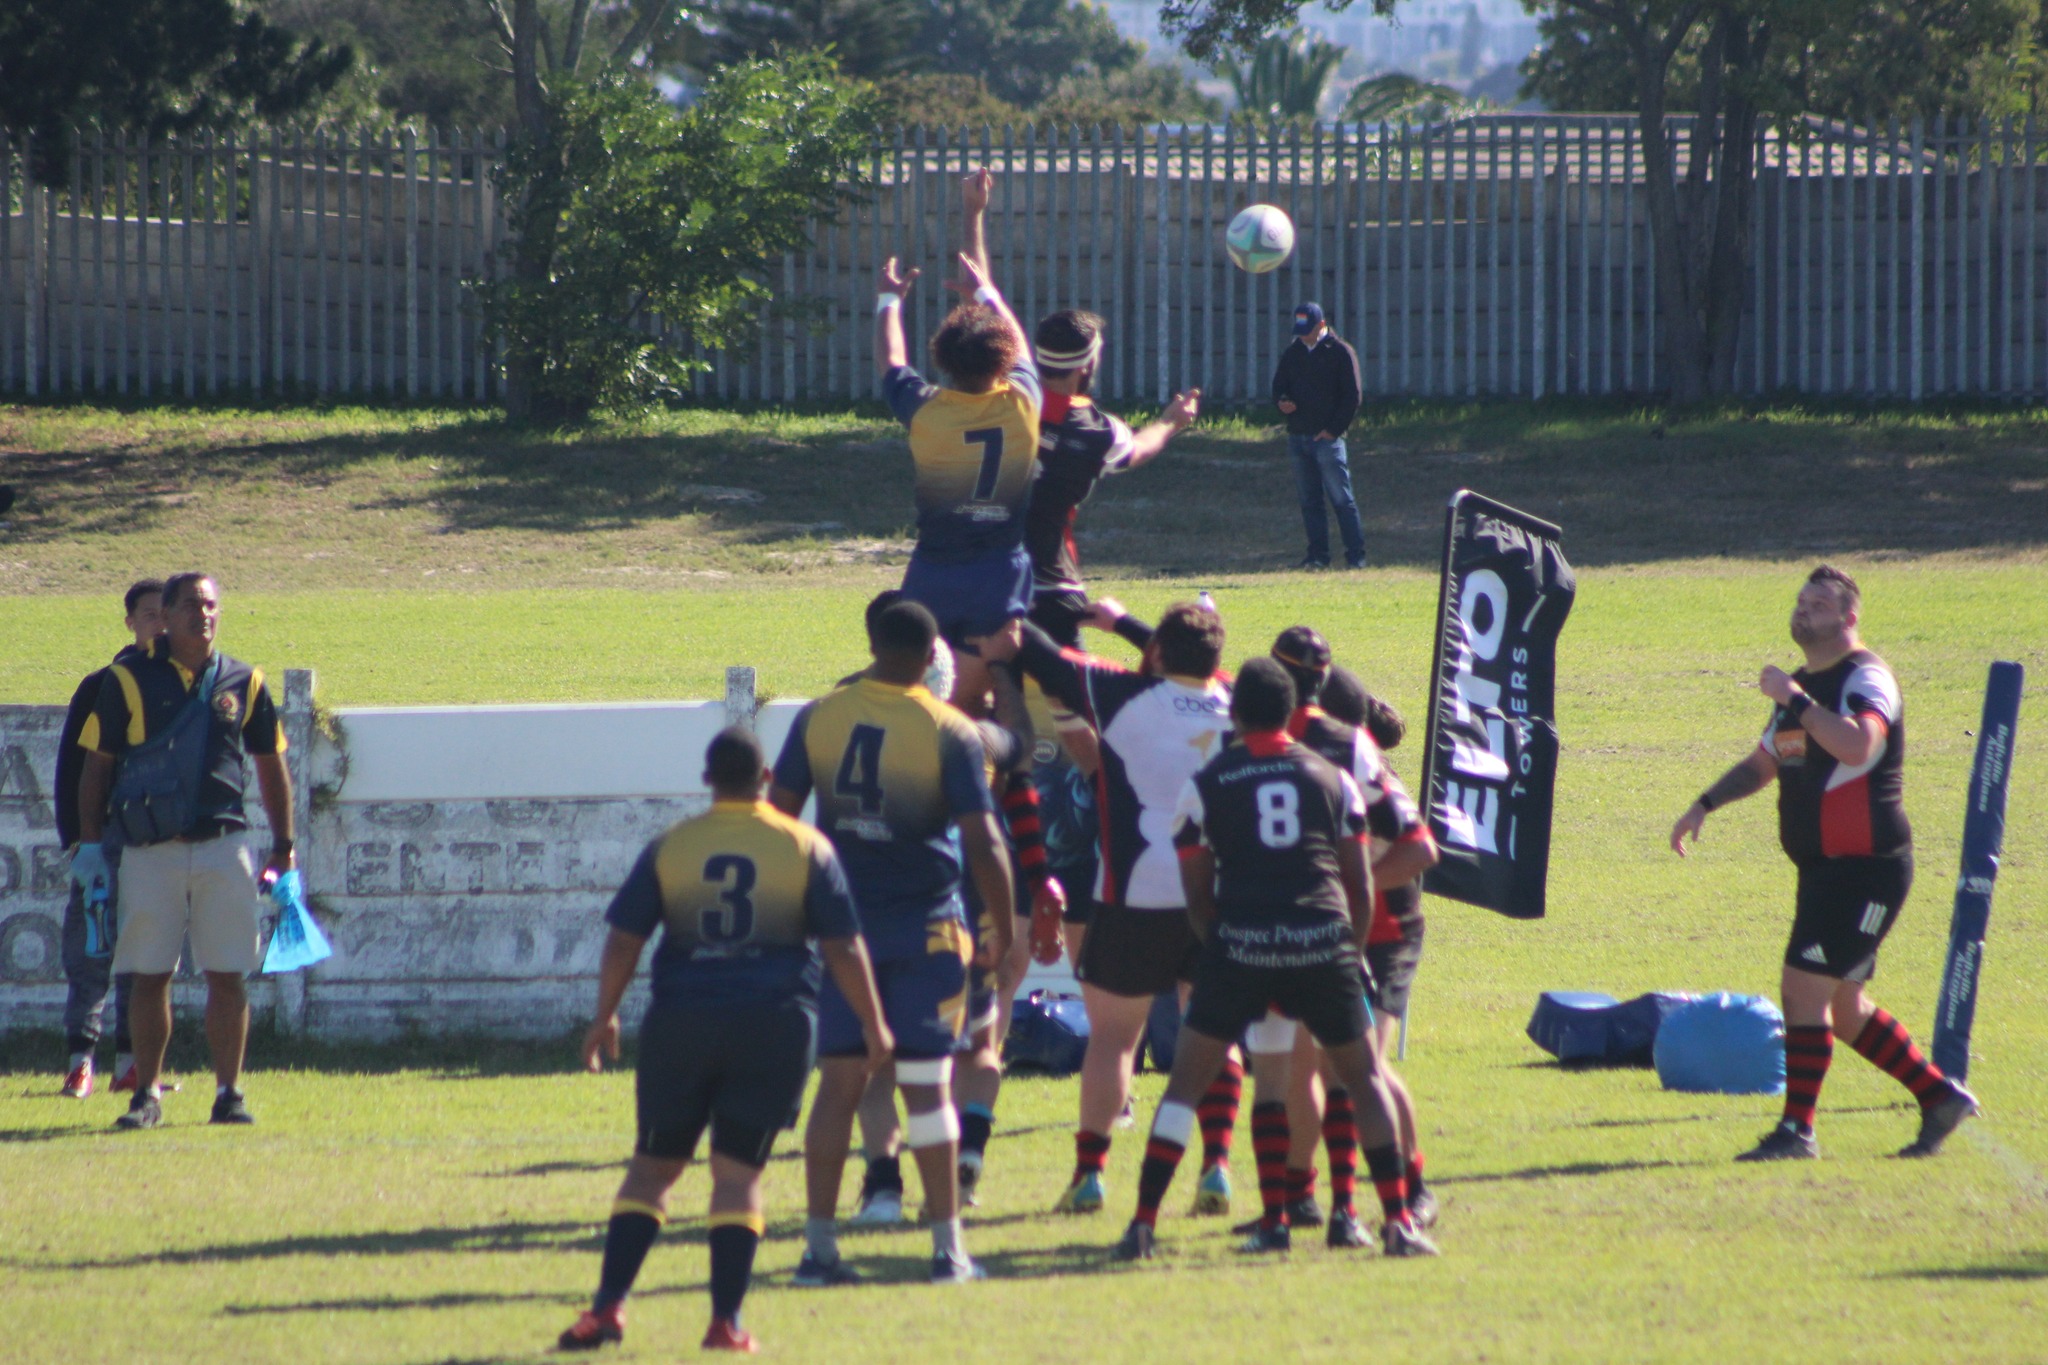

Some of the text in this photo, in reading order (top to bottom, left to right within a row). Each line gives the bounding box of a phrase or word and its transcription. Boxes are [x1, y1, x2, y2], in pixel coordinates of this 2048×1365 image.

[963, 426, 1004, 501] 7
[1511, 646, 1532, 798] TOWERS
[833, 722, 886, 816] 4
[1256, 780, 1300, 848] 8
[698, 851, 758, 943] 3
[1274, 920, 1341, 948] Property
[1226, 945, 1334, 968] Maintenance
